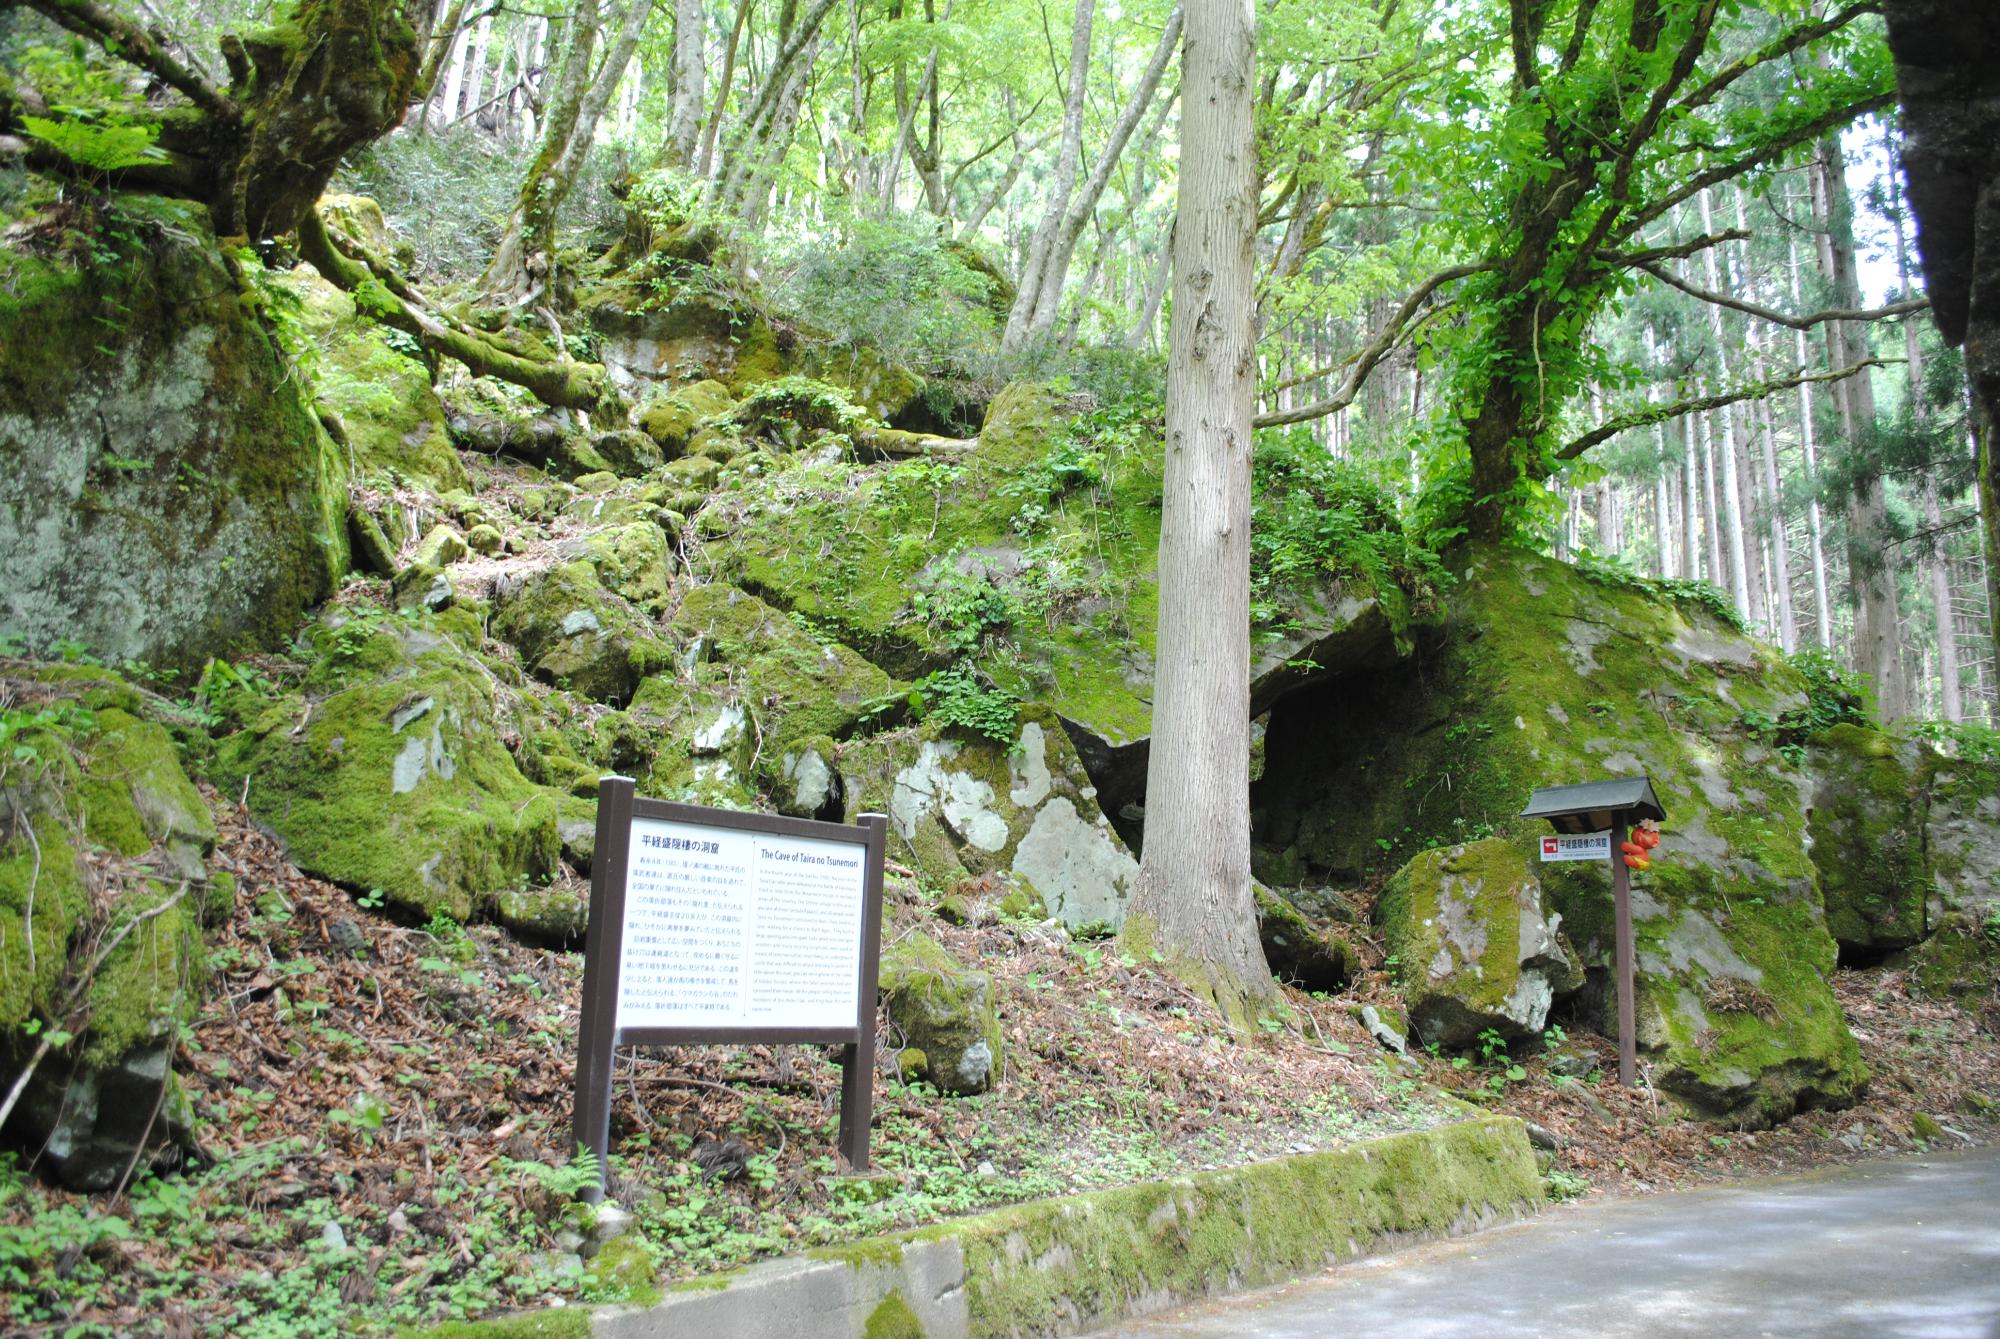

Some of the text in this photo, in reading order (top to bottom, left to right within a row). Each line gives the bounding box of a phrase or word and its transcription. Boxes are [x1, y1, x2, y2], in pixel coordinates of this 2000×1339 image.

[641, 834, 720, 855] 平経盛隠棲の洞窟
[761, 848, 859, 869] The Cave of Taira no Tsunemori
